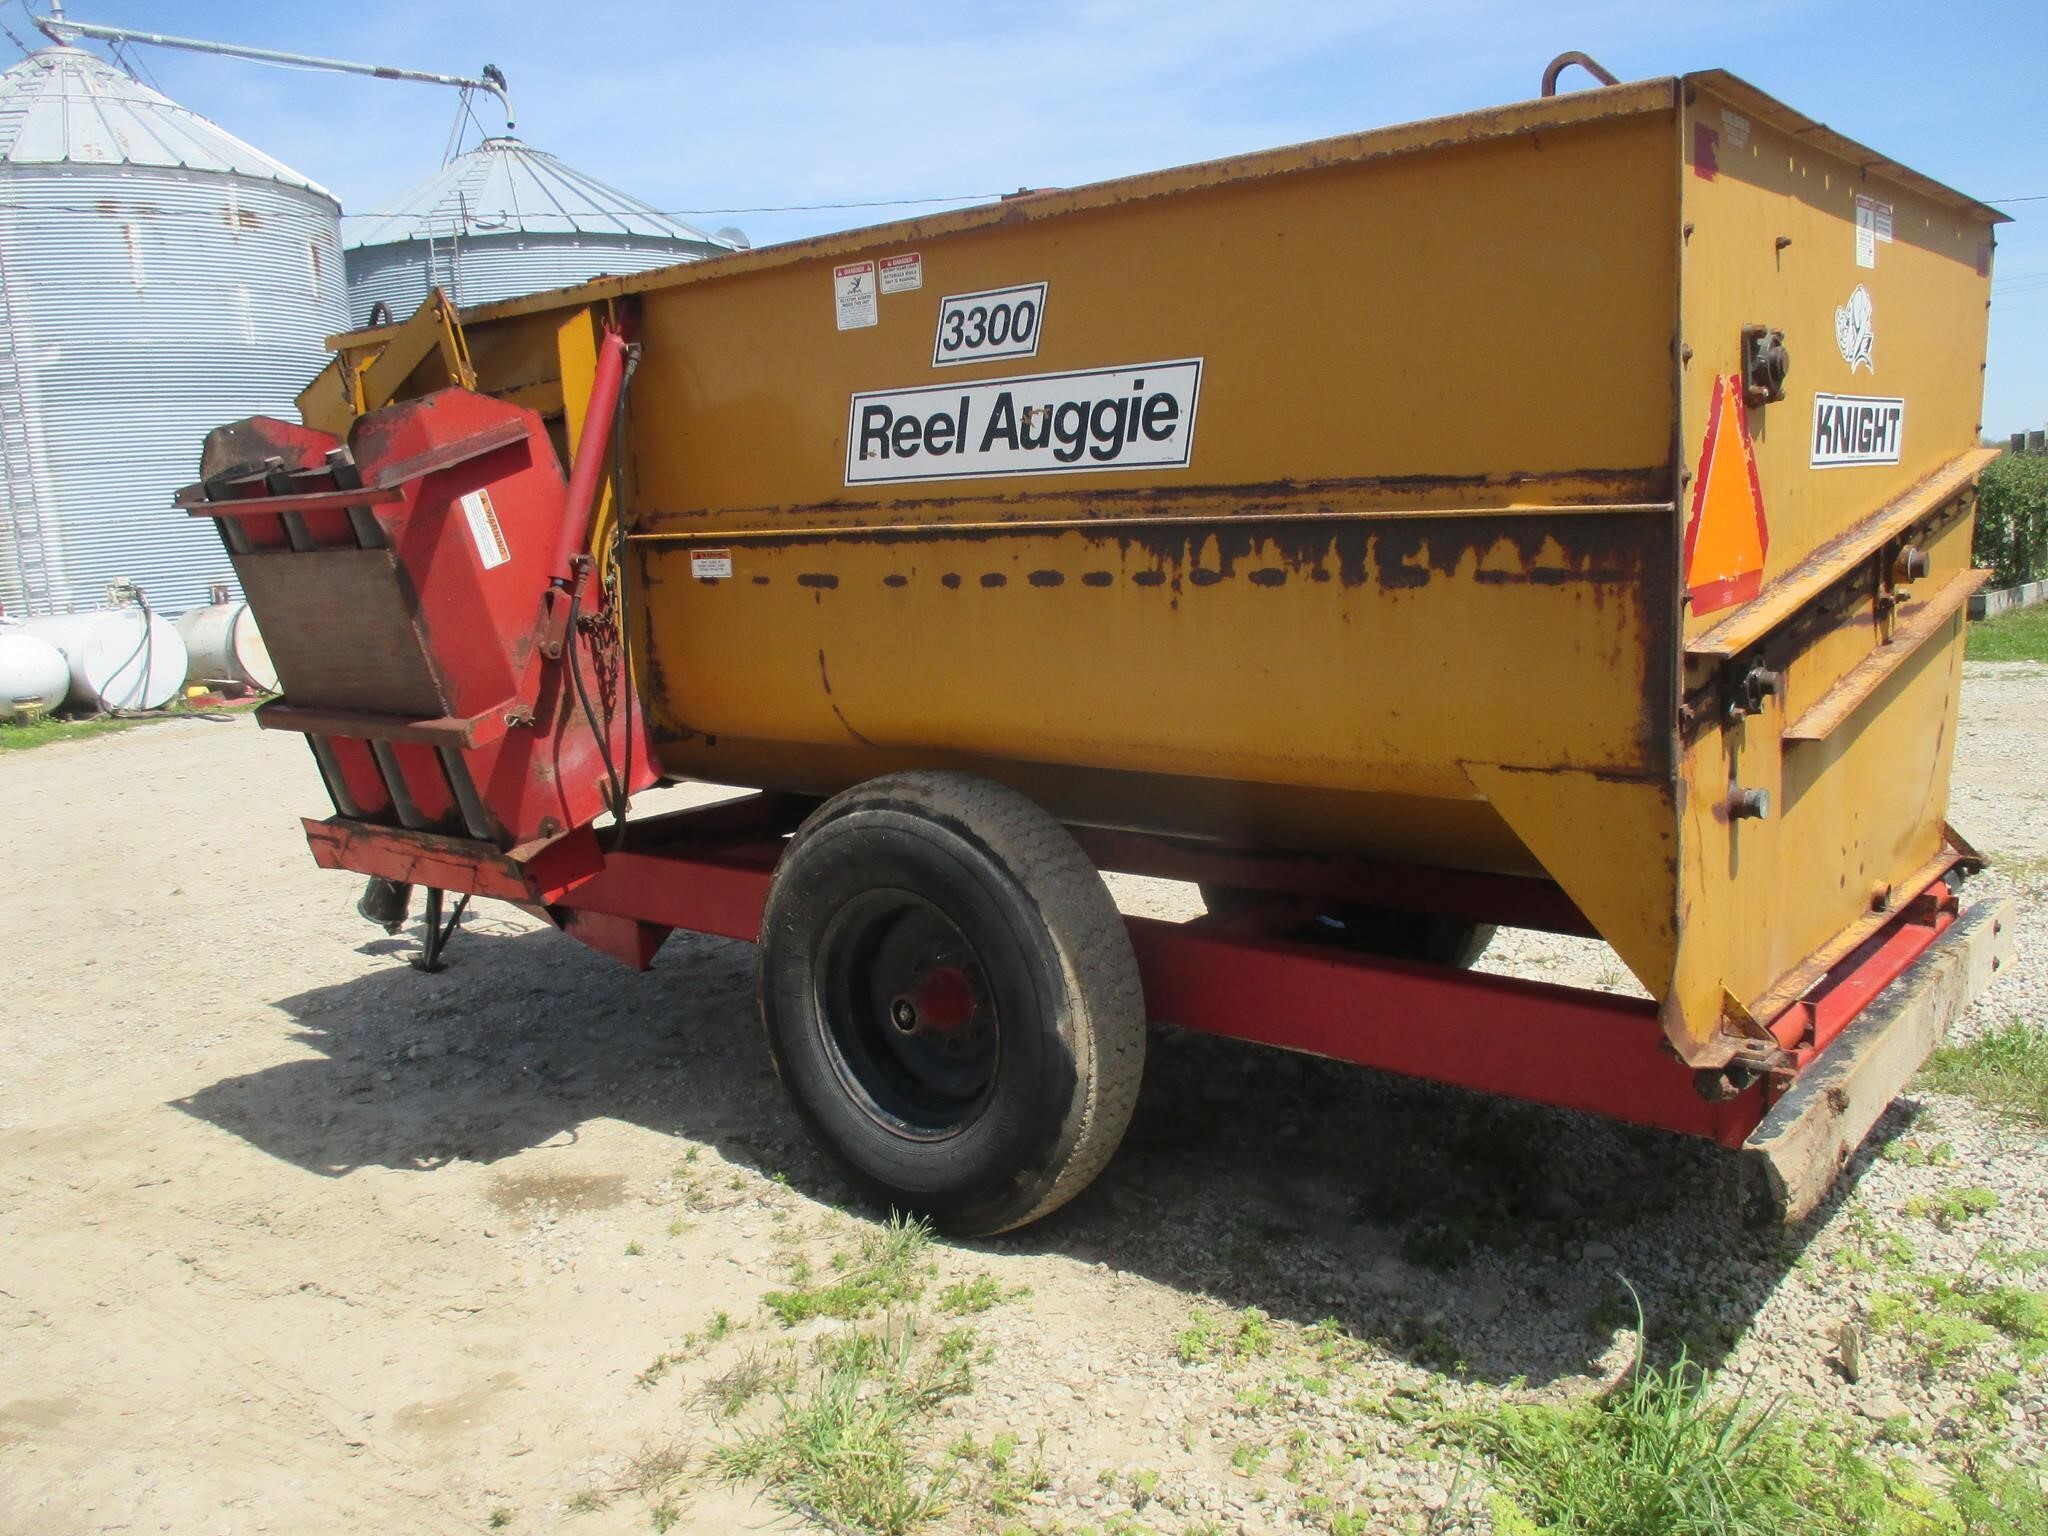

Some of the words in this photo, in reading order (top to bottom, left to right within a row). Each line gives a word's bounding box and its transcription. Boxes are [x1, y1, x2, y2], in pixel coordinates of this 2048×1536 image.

[943, 300, 1036, 352] 3300
[858, 395, 971, 461] Reel
[979, 378, 1179, 463] Auggie
[1815, 404, 1901, 455] KNIGHT
[486, 509, 507, 554] WARNING
